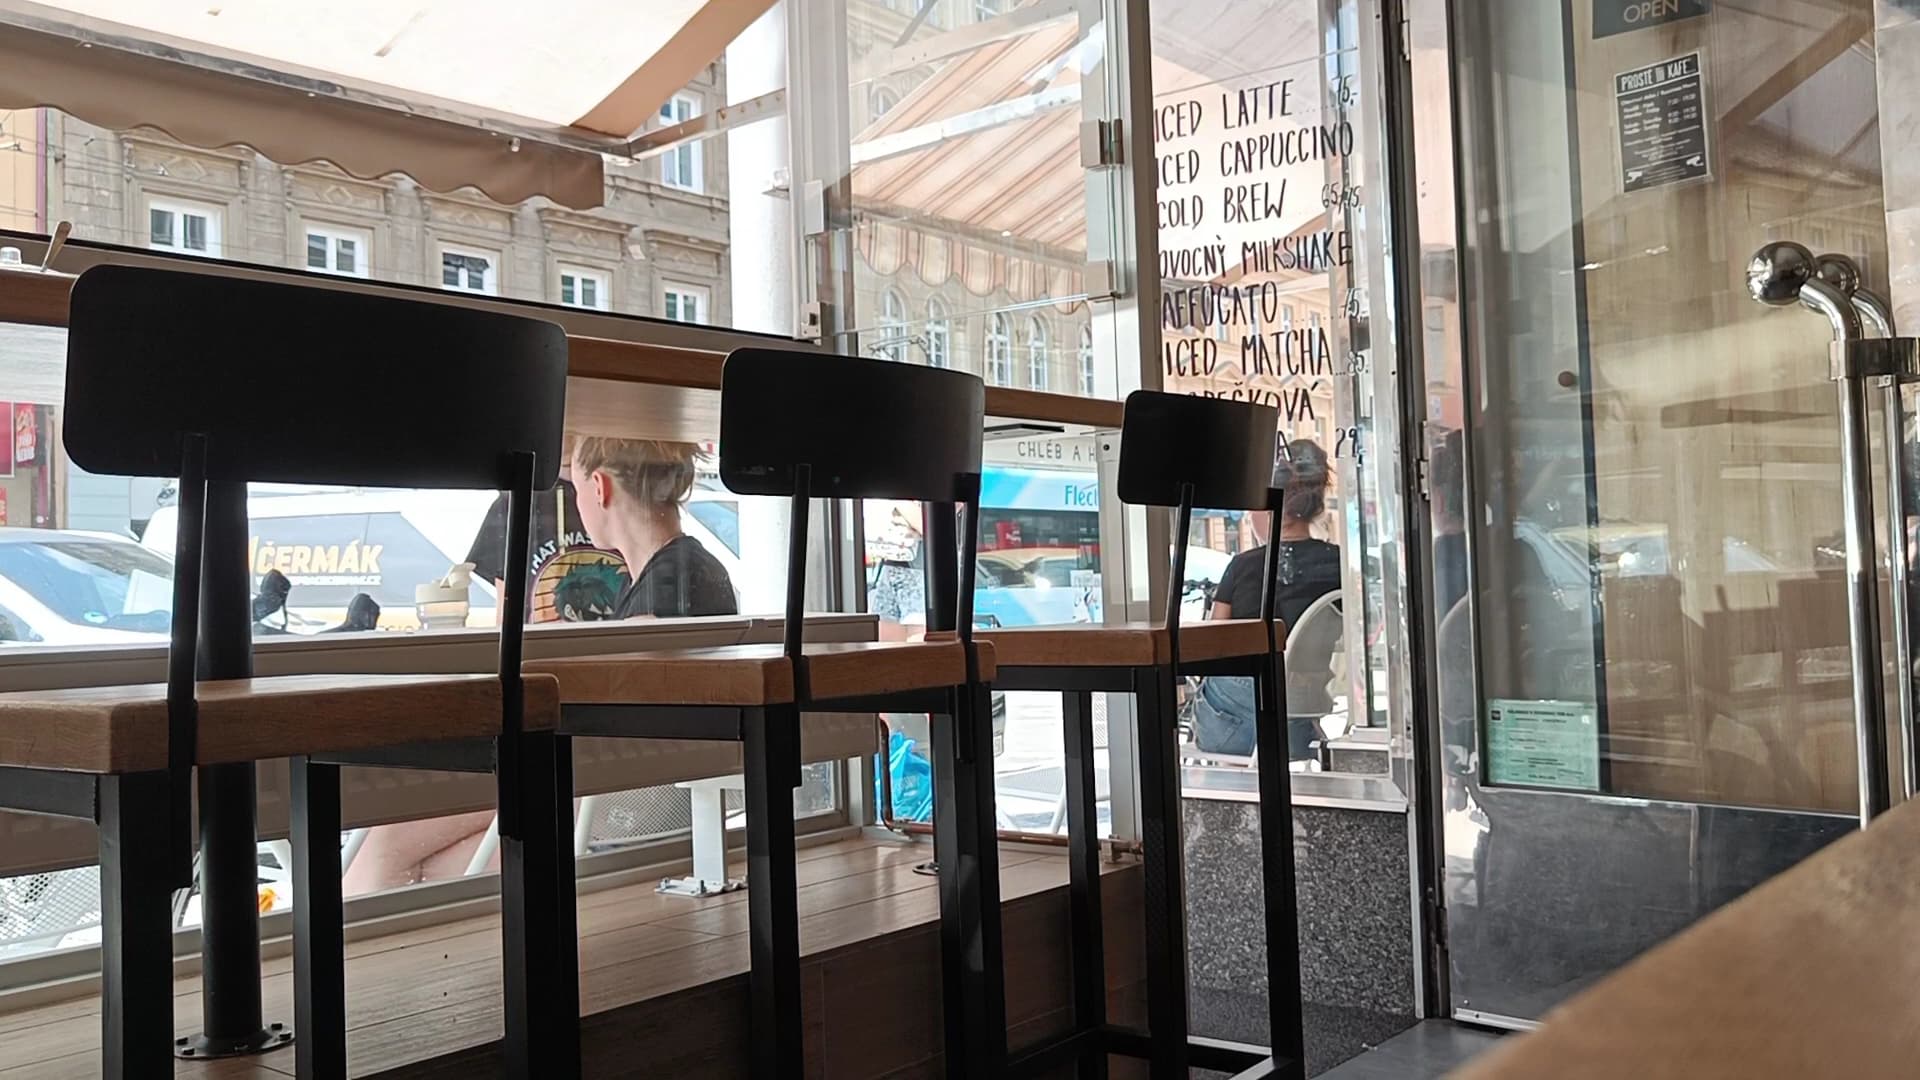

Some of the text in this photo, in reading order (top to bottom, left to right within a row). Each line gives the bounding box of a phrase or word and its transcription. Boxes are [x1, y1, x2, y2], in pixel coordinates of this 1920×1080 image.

[1623, 0, 1679, 23] OPEN
[1154, 100, 1202, 143] ICED
[1222, 78, 1294, 130] LATTE
[1220, 122, 1353, 177] CAPPUCCINO
[1157, 195, 1203, 230] COLD
[1223, 178, 1287, 224] BREW
[1241, 230, 1353, 274] MILKSHAKE
[1165, 338, 1217, 377] ICED
[1241, 327, 1333, 377] MATCHA
[1073, 445, 1081, 462] A
[256, 538, 383, 575] ČERMÁK
